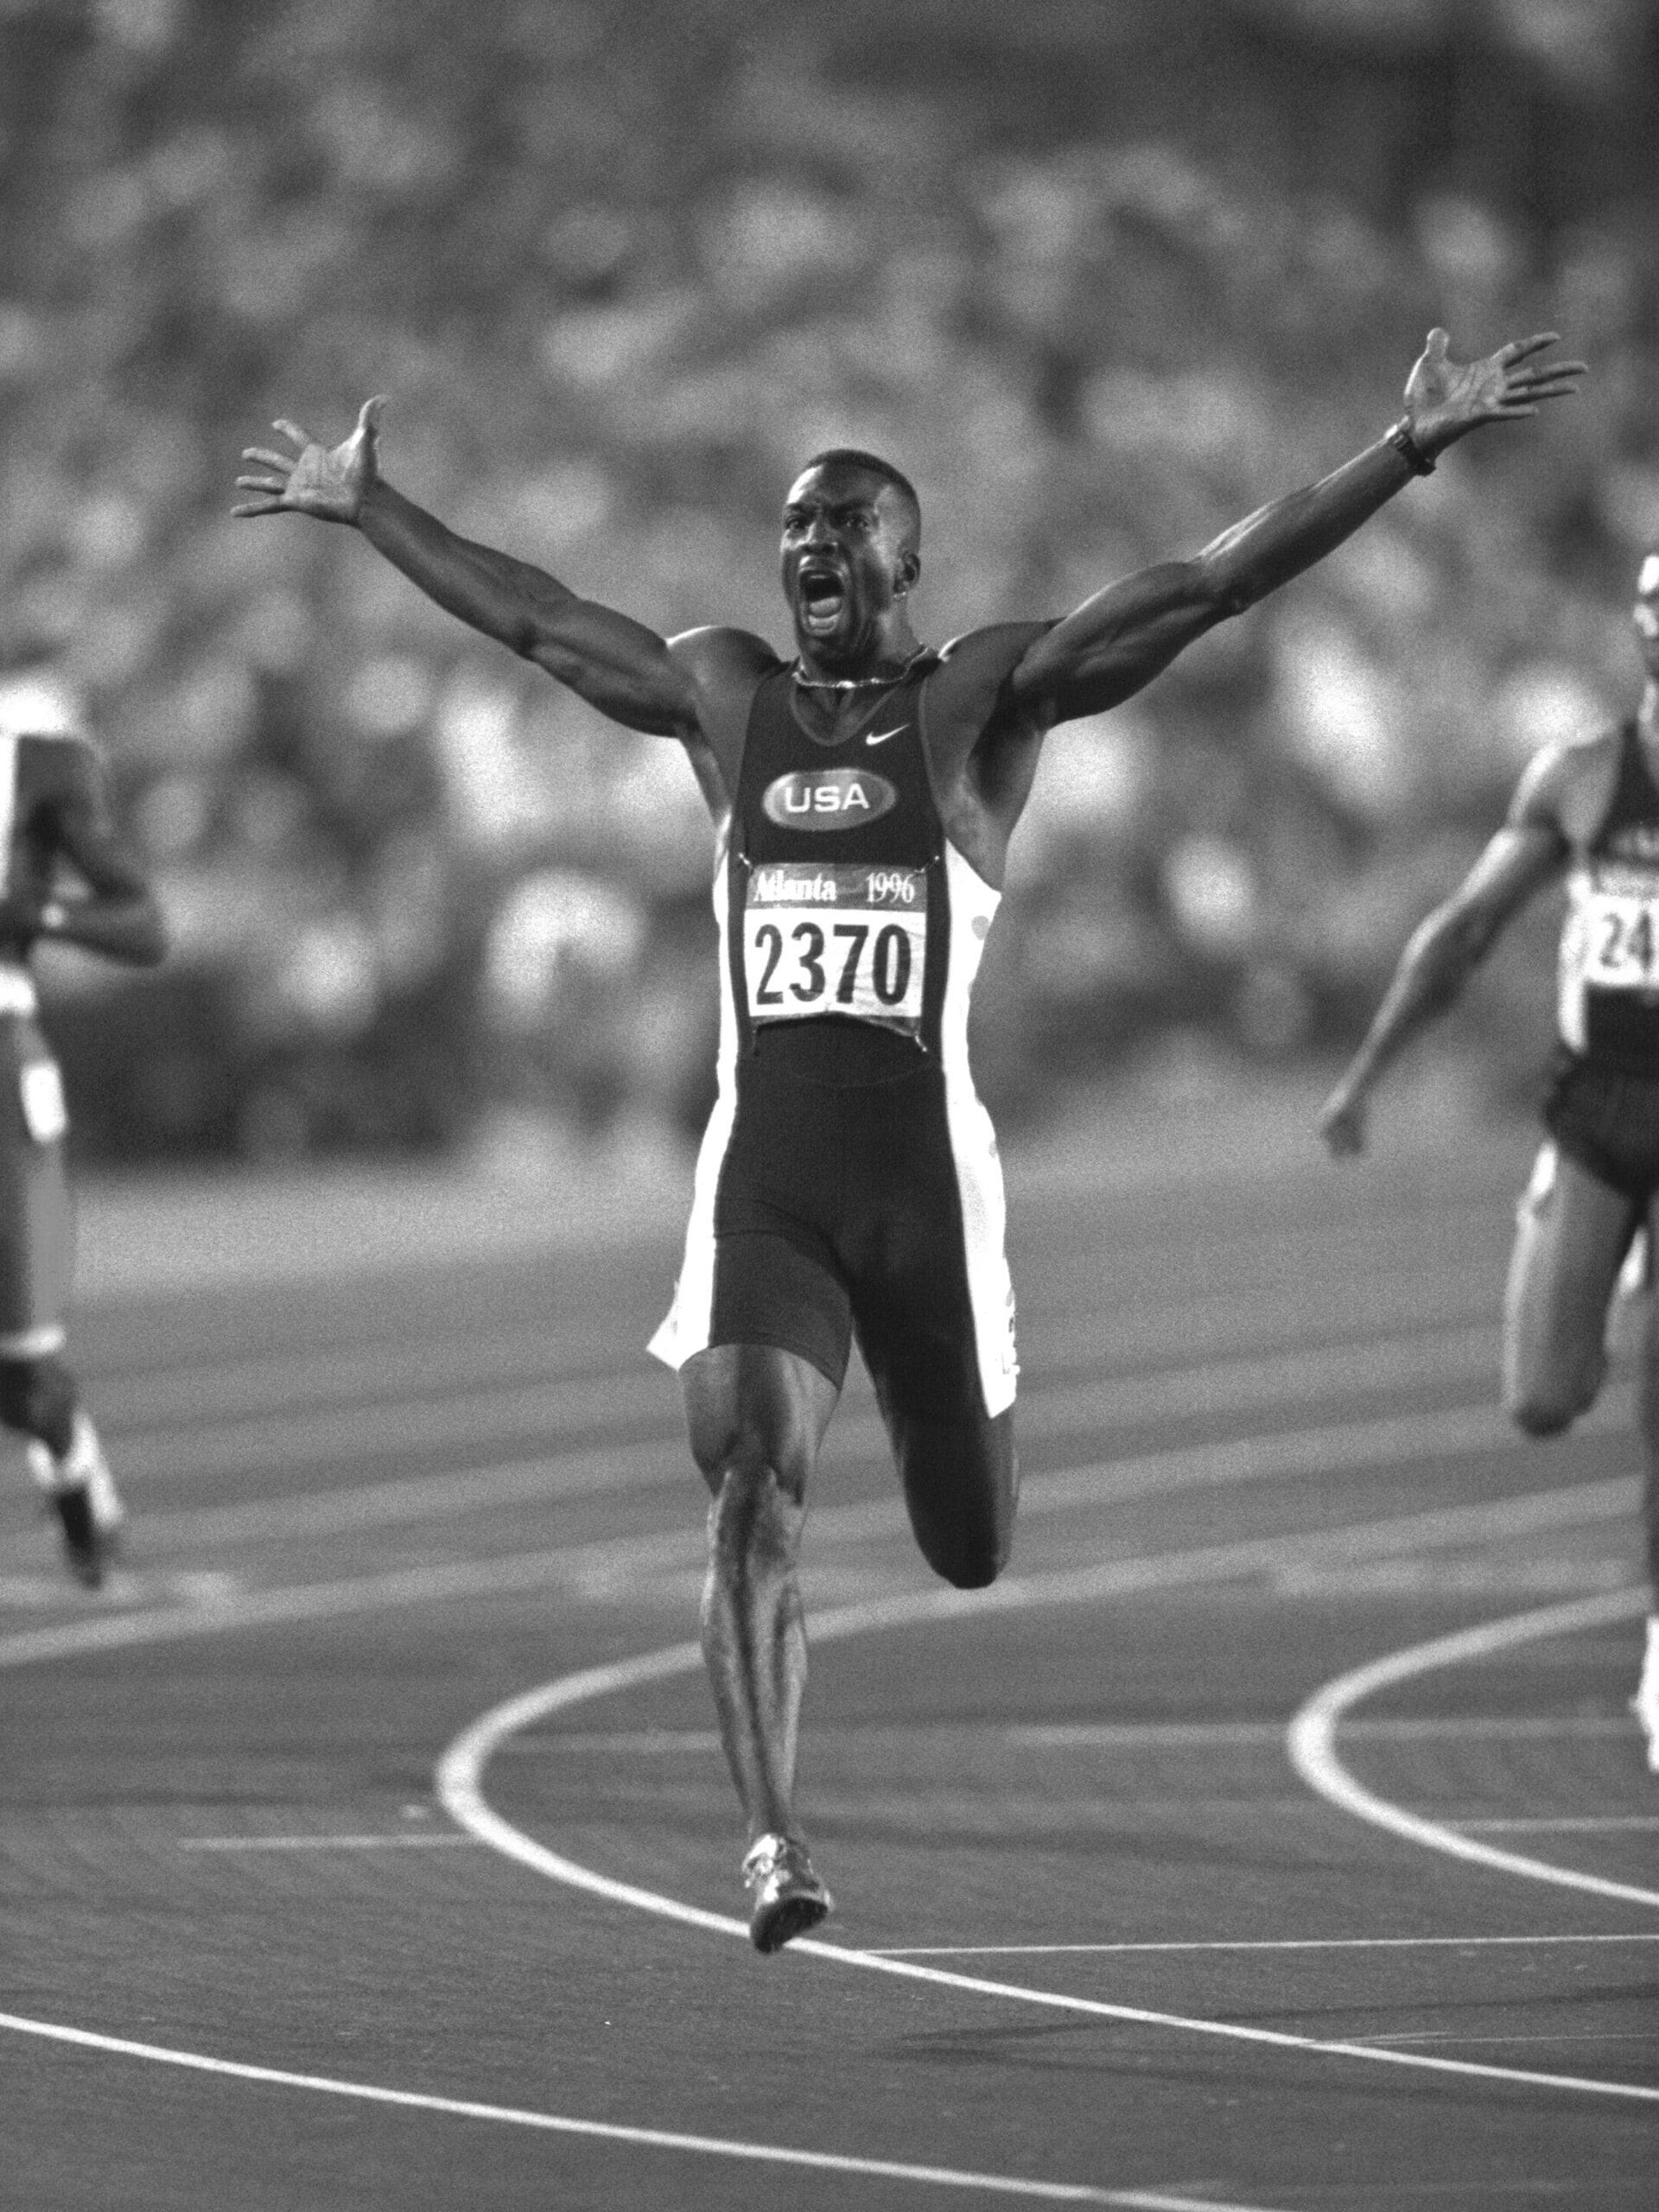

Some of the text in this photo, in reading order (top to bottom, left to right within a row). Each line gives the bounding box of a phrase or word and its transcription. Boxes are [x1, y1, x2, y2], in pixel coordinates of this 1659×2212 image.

[785, 782, 870, 812] USA
[753, 869, 915, 903] Atlanta 1996
[754, 922, 912, 1006] 2370
